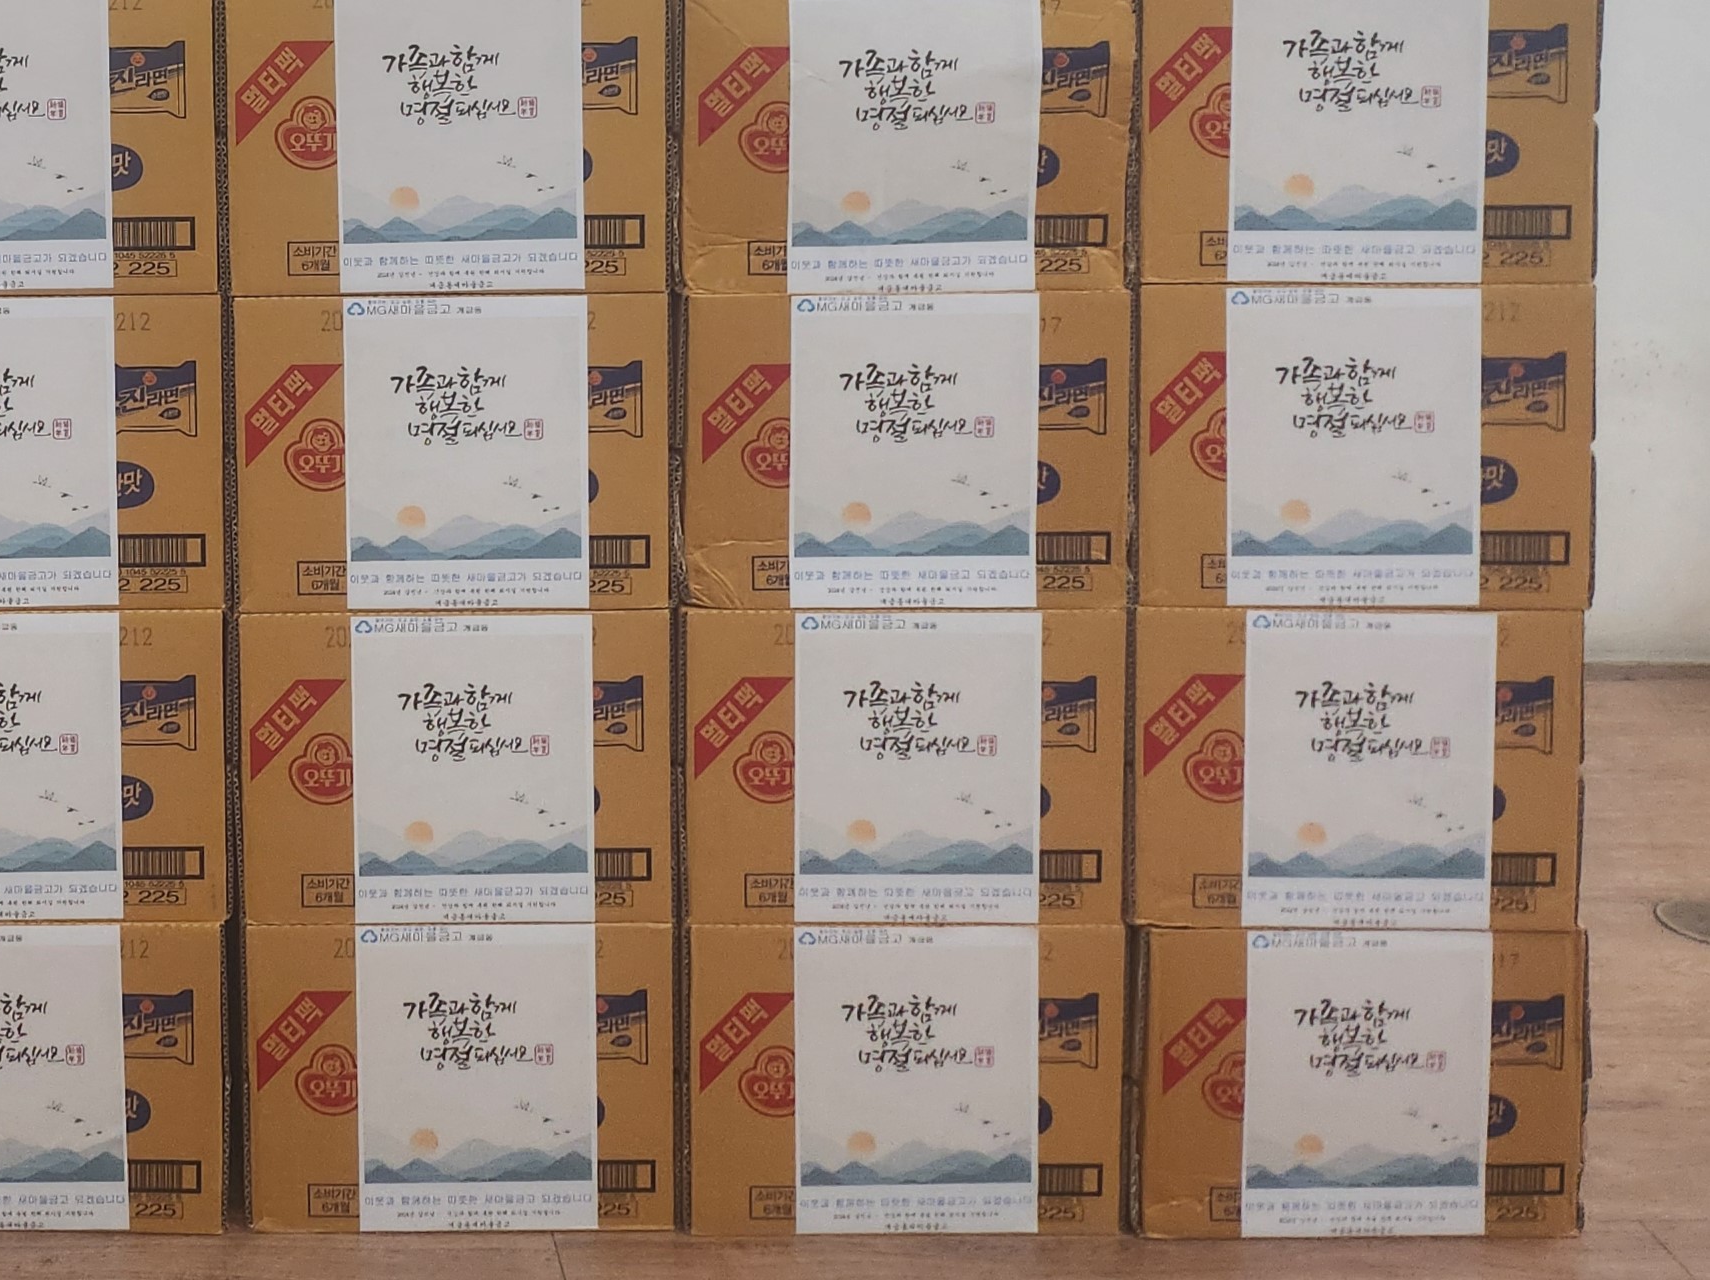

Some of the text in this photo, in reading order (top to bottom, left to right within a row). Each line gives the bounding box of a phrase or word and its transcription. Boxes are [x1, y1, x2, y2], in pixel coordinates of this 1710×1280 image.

[243, 46, 304, 112] 멀티팩
[1158, 32, 1221, 100] 멀티팩
[1306, 56, 1381, 86] 행복한
[407, 69, 478, 99] 행복한
[708, 50, 769, 116] 멀티팩
[863, 75, 936, 104] 행복한
[293, 245, 337, 258] 소비기간
[301, 259, 330, 272] 6개월
[1039, 258, 1081, 272] 225
[1498, 250, 1544, 265] 225
[127, 261, 169, 275] 225
[253, 369, 313, 434] 멀티팩
[711, 368, 771, 433] 멀티팩
[863, 389, 935, 417] 행복한
[1159, 356, 1222, 424] 멀티팩
[1300, 382, 1374, 412] 행복한
[415, 391, 485, 420] 행복한
[138, 577, 181, 591] 225
[1042, 575, 1084, 589] 225
[258, 685, 317, 749] 멀티팩
[422, 708, 492, 736] 행복한
[703, 682, 763, 747] 멀티팩
[867, 706, 939, 735] 행복한
[1153, 679, 1214, 745] 멀티팩
[1318, 707, 1391, 737] 행복한
[138, 890, 178, 903] 225
[1034, 893, 1074, 906] 225
[265, 996, 324, 1060] 멀티팩
[427, 1017, 496, 1045] 행복한
[709, 997, 768, 1061] 멀티팩
[866, 1019, 936, 1047] 행복한
[1317, 1024, 1389, 1052] 행복한
[134, 1203, 175, 1217] 225
